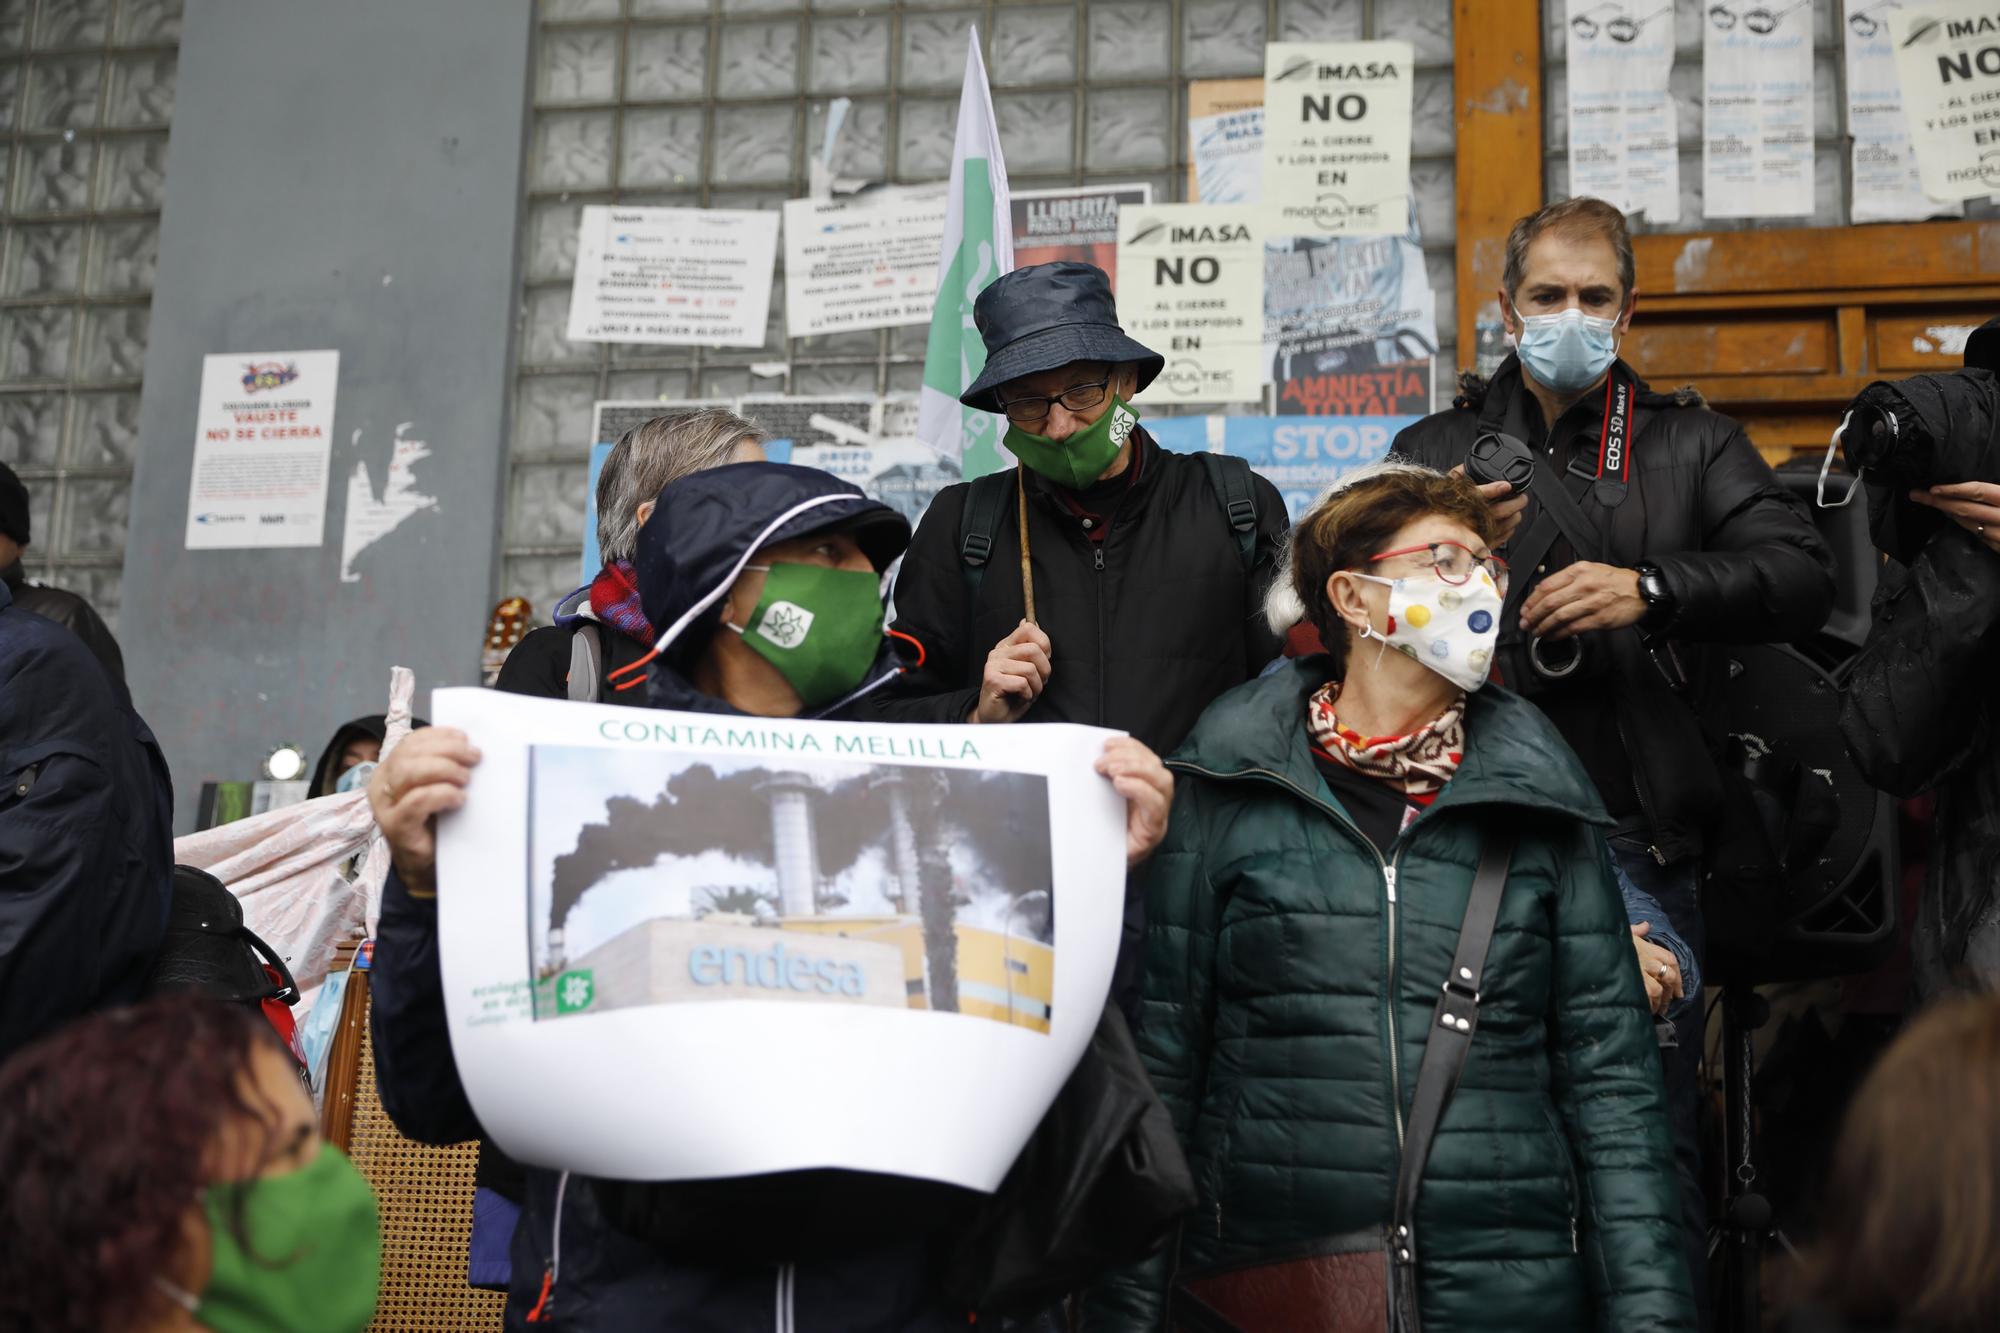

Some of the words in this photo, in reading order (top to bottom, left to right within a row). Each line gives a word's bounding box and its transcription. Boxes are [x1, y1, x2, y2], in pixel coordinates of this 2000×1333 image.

[1318, 64, 1398, 81] IMASA
[1938, 47, 2000, 83] NO
[1302, 94, 1367, 122] NO
[1301, 137, 1316, 147] AL
[1323, 136, 1374, 147] CIERRE
[1290, 155, 1316, 165] LOS
[1321, 153, 1390, 165] DESPIDOS
[1317, 171, 1347, 186] EN
[1172, 225, 1252, 244] IMASA
[1155, 257, 1221, 285] NO
[1155, 301, 1170, 311] AL
[1176, 300, 1227, 311] CIERRE
[1143, 319, 1169, 329] LOS
[1174, 317, 1244, 328] DESPIDOS
[1172, 336, 1201, 350] EN
[1282, 368, 1425, 400] AMNISTÍA
[1616, 394, 1626, 416] Mark
[207, 429, 229, 441] NO
[236, 428, 256, 439] SE
[261, 425, 321, 438] CIERRA
[1610, 416, 1625, 435] 5D
[1272, 424, 1388, 460] STOP
[1606, 436, 1622, 470] EOS
[599, 719, 823, 752] CONTAMINA
[836, 735, 982, 761] MELILLA
[688, 940, 866, 997] endesa
